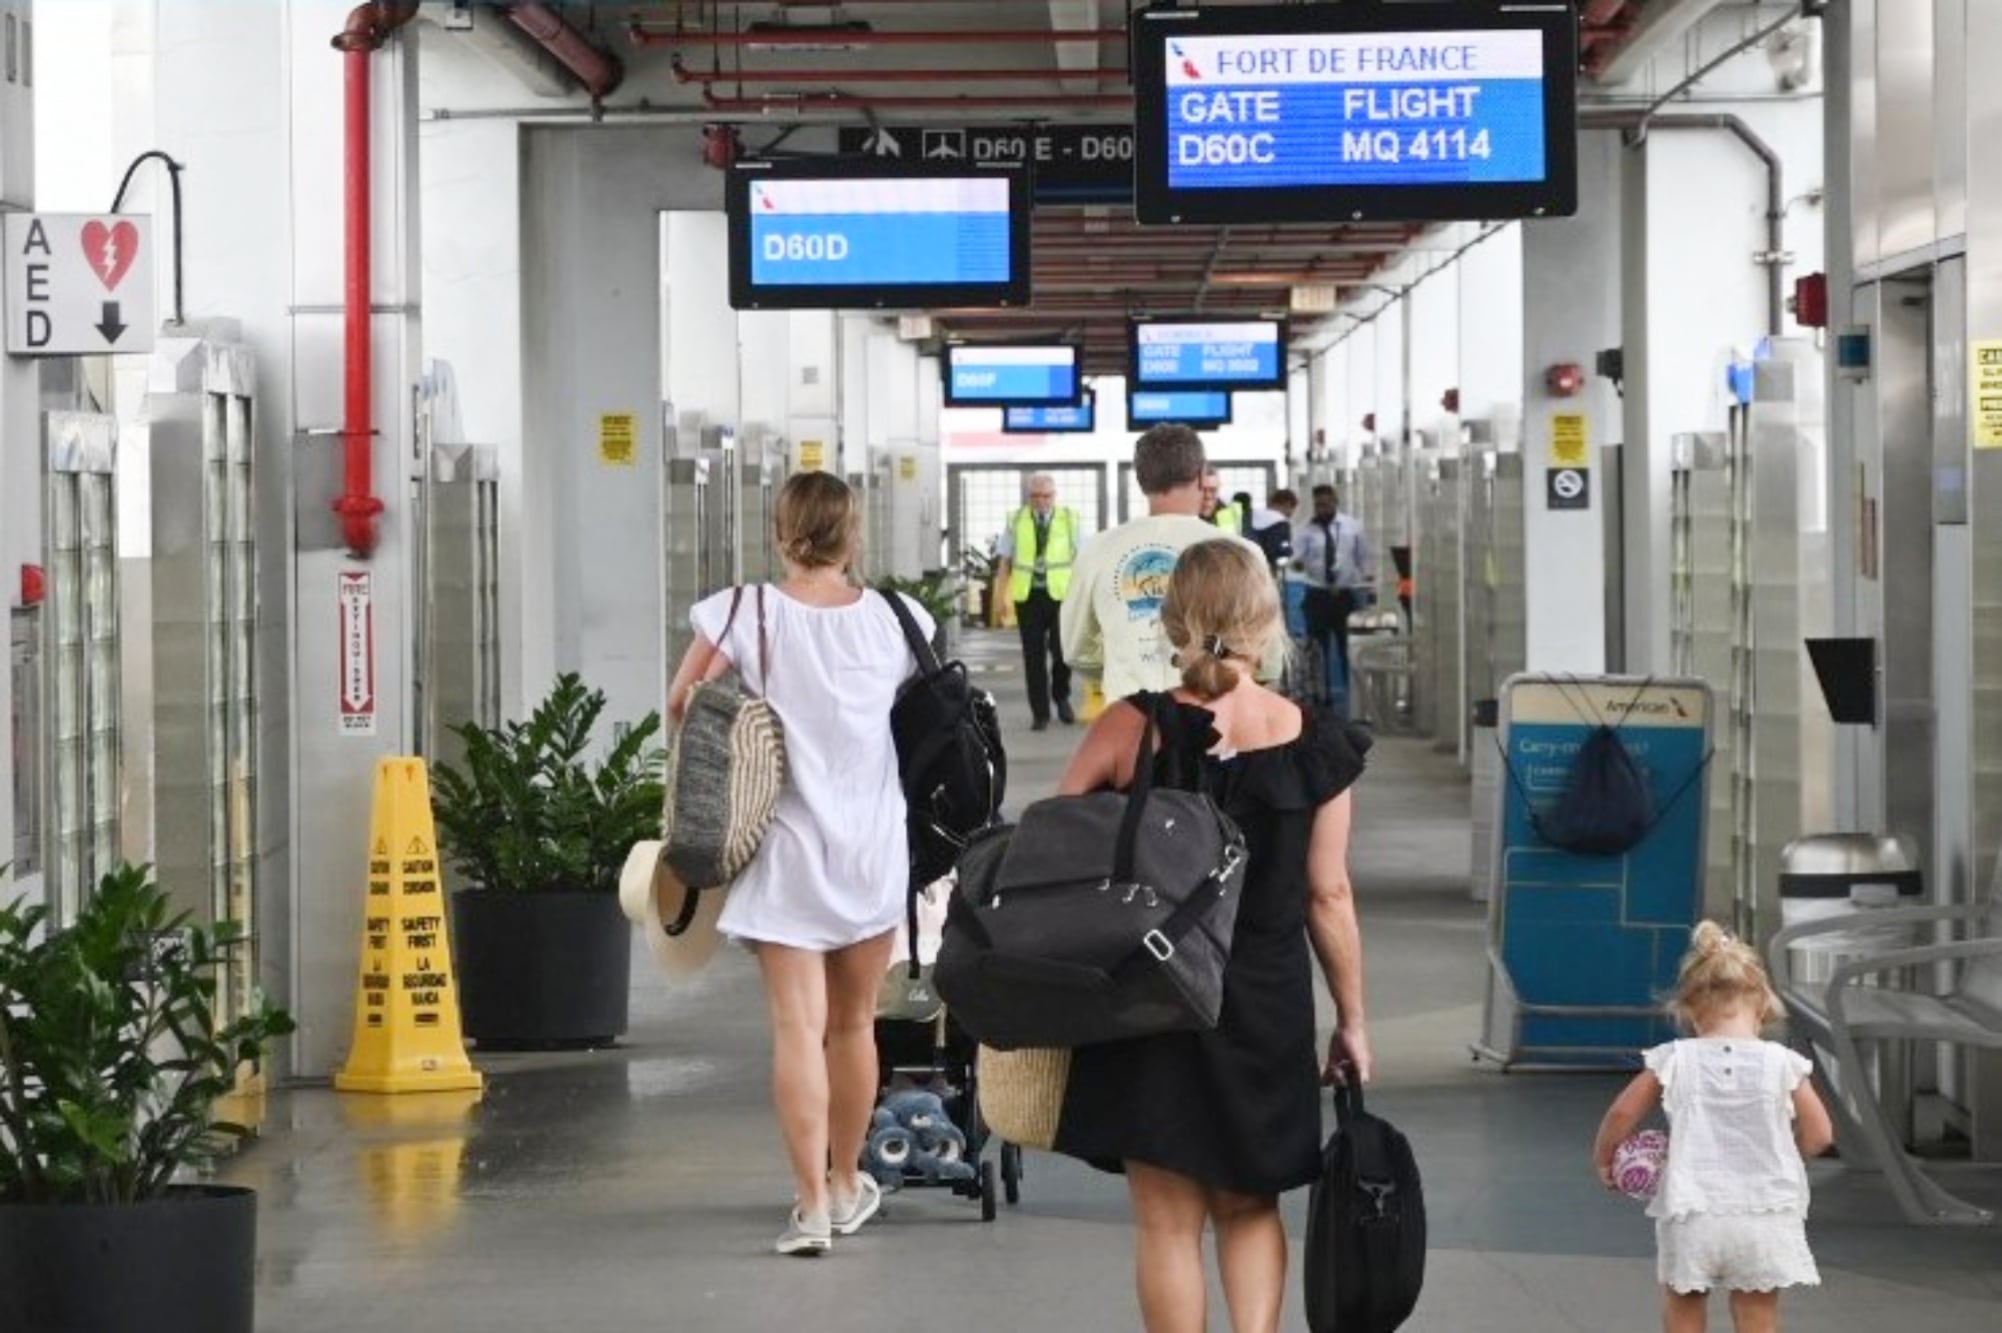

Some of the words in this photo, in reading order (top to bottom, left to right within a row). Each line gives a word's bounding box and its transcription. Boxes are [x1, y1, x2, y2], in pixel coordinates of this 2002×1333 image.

[1217, 49, 1299, 75] FORT
[1309, 48, 1346, 74] DE
[1358, 45, 1478, 71] FRANCE
[1180, 91, 1280, 123] GATE
[1344, 86, 1481, 120] FLIGHT
[1178, 132, 1276, 166] D60C
[1342, 130, 1399, 163] MQ
[1408, 127, 1492, 161] 4114
[763, 233, 848, 261] D60D
[23, 217, 52, 347] AED
[1605, 699, 1670, 714] American
[401, 916, 441, 932] SAFETY
[407, 932, 436, 949] FIRST
[416, 956, 431, 971] LA
